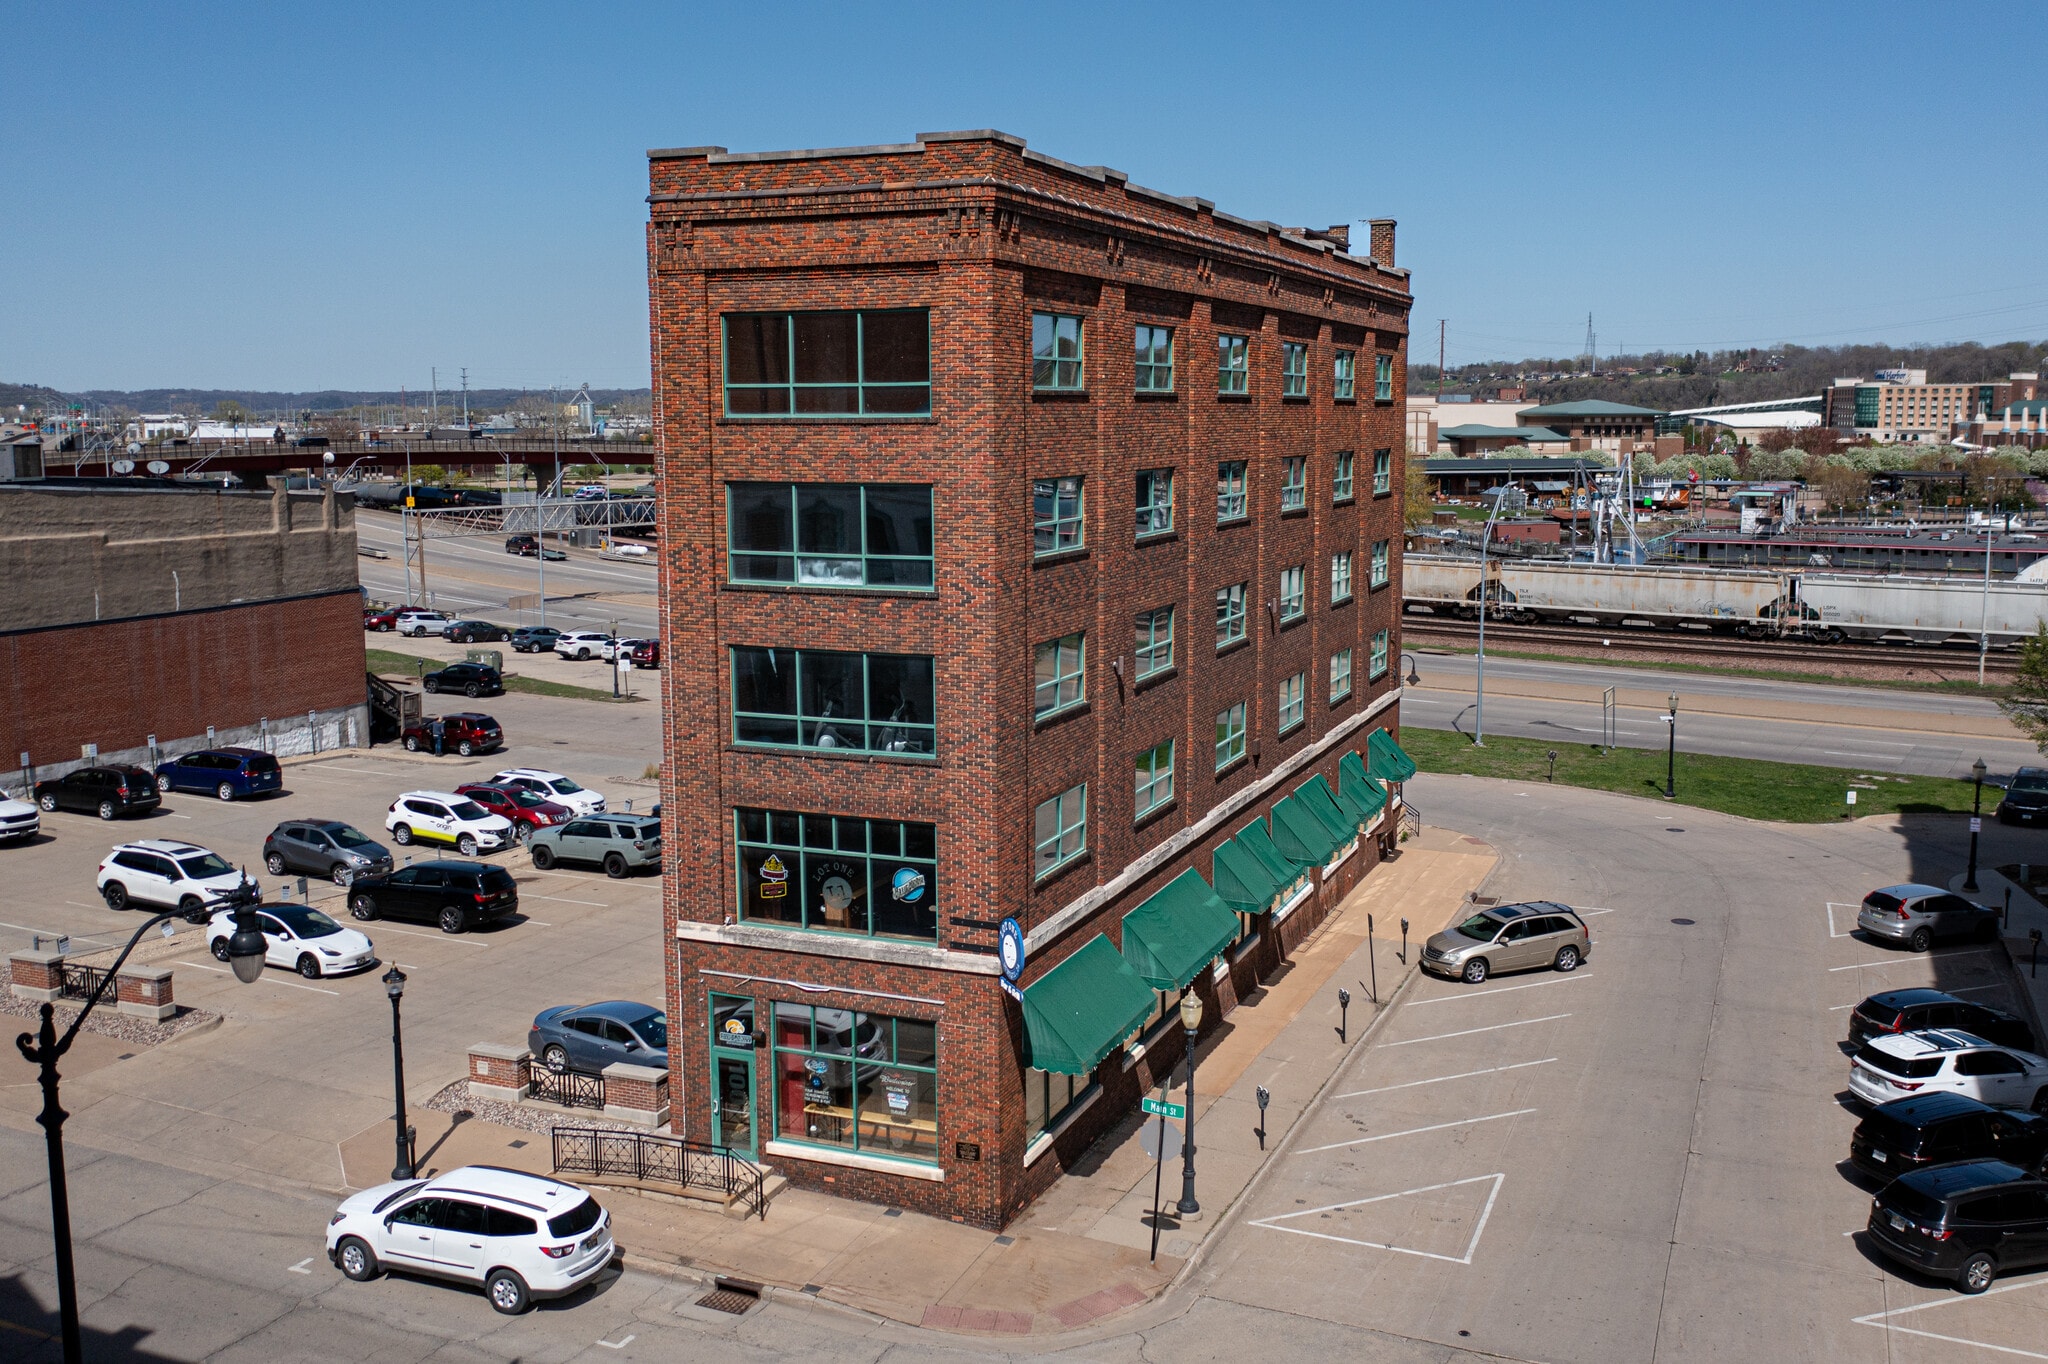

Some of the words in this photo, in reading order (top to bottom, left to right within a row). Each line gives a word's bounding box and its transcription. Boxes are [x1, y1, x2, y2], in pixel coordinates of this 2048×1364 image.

[1886, 370, 1906, 380] Harbor
[436, 823, 452, 831] origin
[812, 863, 830, 882] LOT
[833, 862, 855, 878] ONE
[1000, 921, 1008, 939] LOT
[1008, 921, 1017, 940] ONE
[1150, 1101, 1167, 1115] Main
[1170, 1107, 1176, 1116] St
